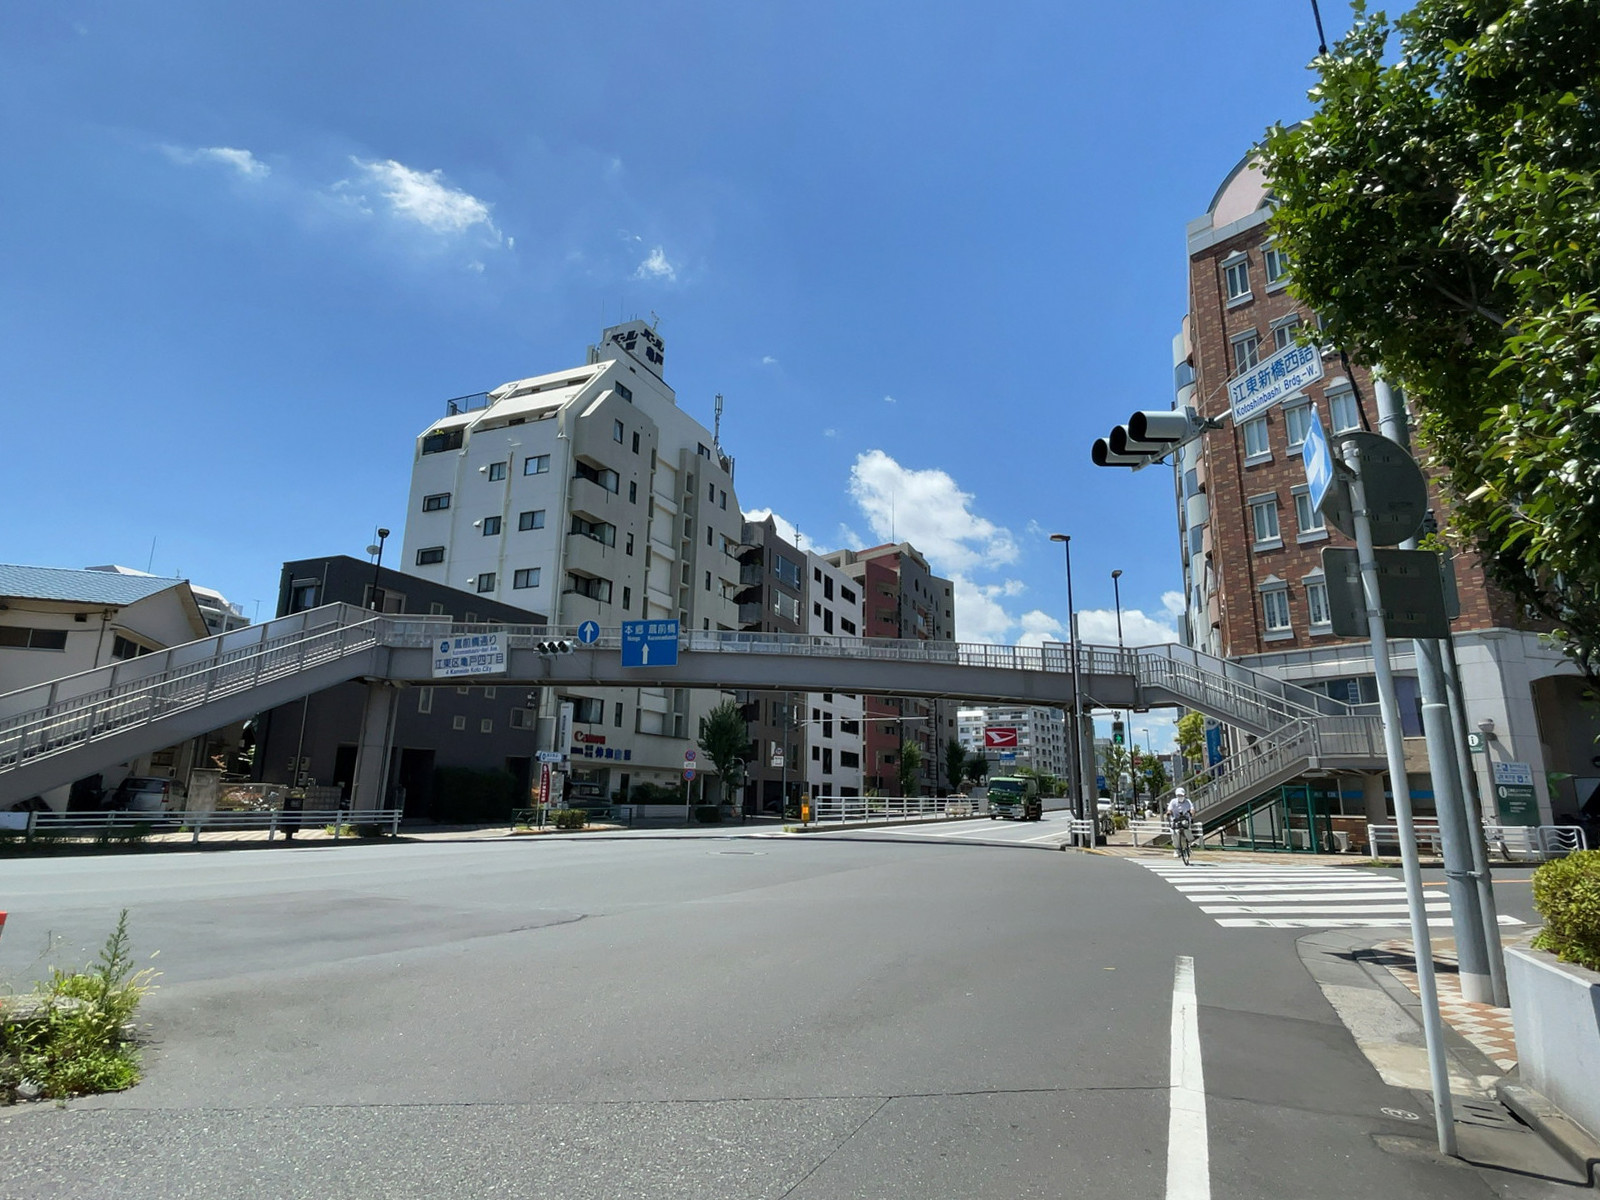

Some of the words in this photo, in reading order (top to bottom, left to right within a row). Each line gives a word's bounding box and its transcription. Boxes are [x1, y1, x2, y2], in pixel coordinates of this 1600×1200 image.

[1233, 346, 1314, 404] 江東新橋西詰
[455, 635, 497, 649] 蔵前橋通り
[435, 653, 504, 669] 江東区亀戸四丁目
